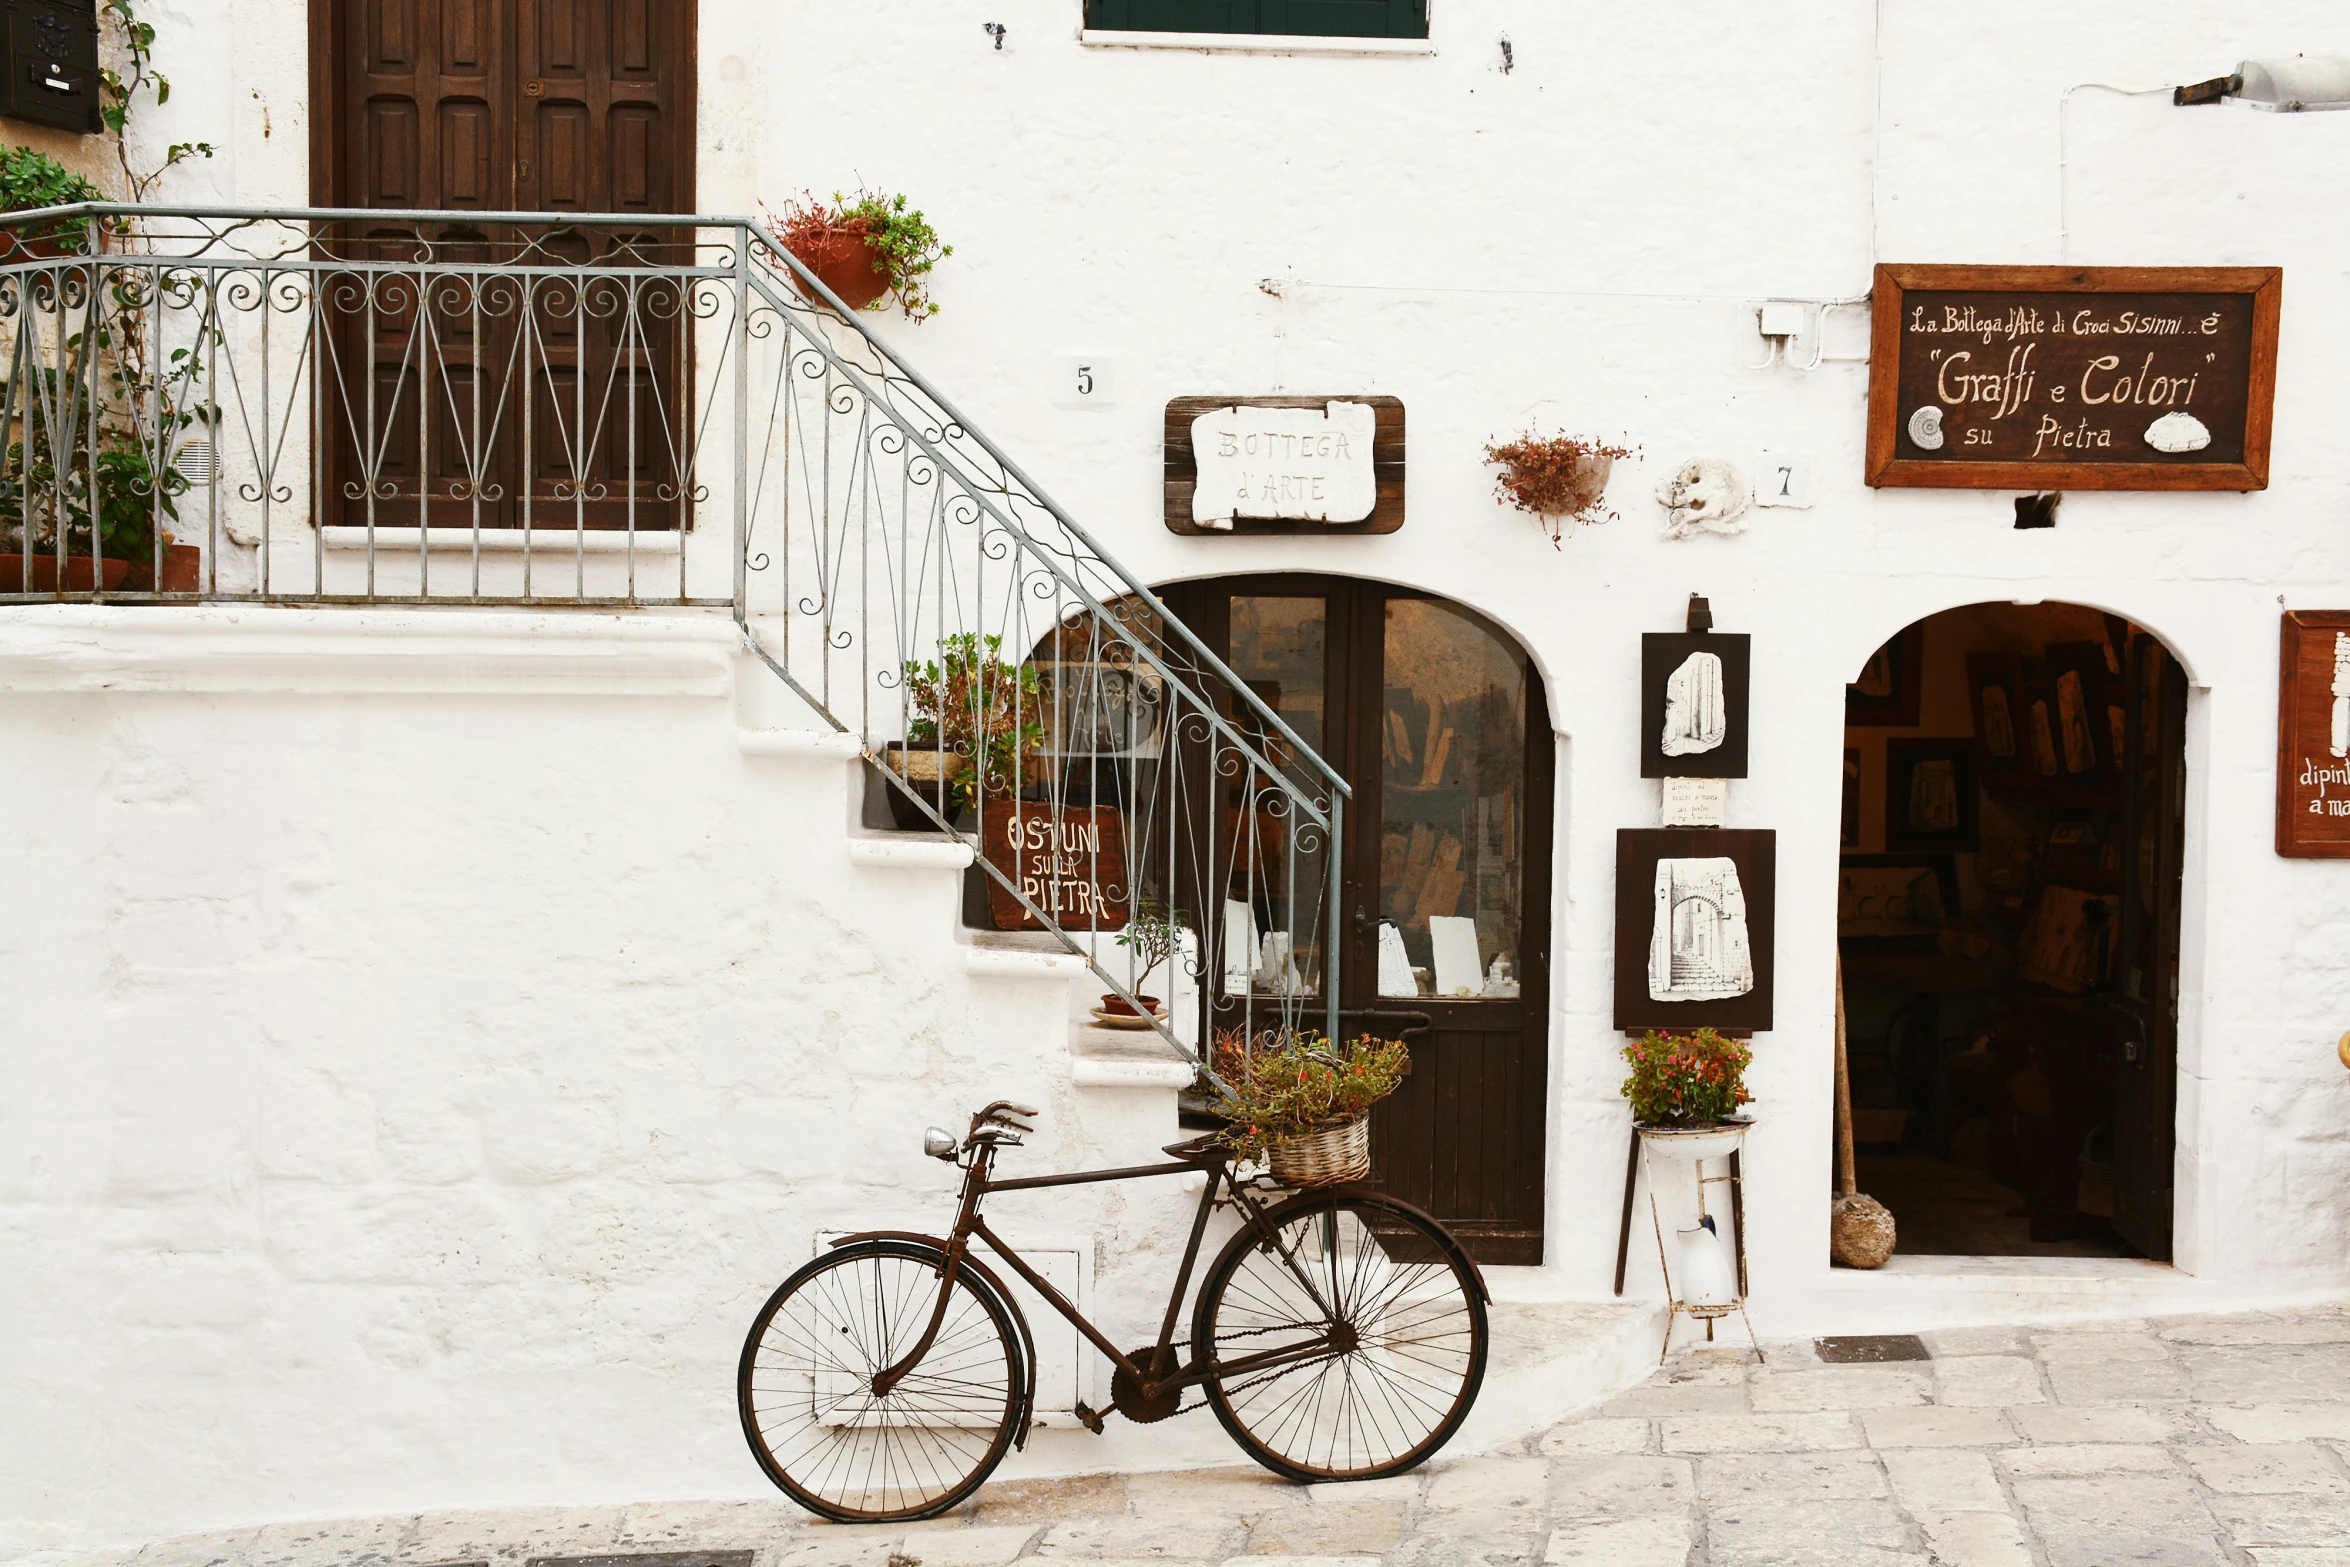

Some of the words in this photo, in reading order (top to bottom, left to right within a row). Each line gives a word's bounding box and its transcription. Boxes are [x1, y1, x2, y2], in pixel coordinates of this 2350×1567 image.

[1910, 305, 1938, 333] La
[1941, 305, 2003, 345] Bottega
[2004, 305, 2045, 342] d'Arte
[2052, 310, 2065, 334] di
[2072, 309, 2110, 336] Croci
[1077, 366, 1093, 395] 5
[2050, 384, 2066, 403] e
[1218, 430, 1353, 461] BOTTEGA
[1964, 427, 1993, 446] su
[2031, 413, 2112, 458] Pietra
[1236, 471, 1326, 504] d'ARTE
[1777, 466, 1793, 496] 7
[2309, 799, 2325, 815] a
[1007, 816, 1100, 853] OSTUNI
[1031, 854, 1078, 877] SULLA
[1023, 876, 1111, 921] PIETRA
